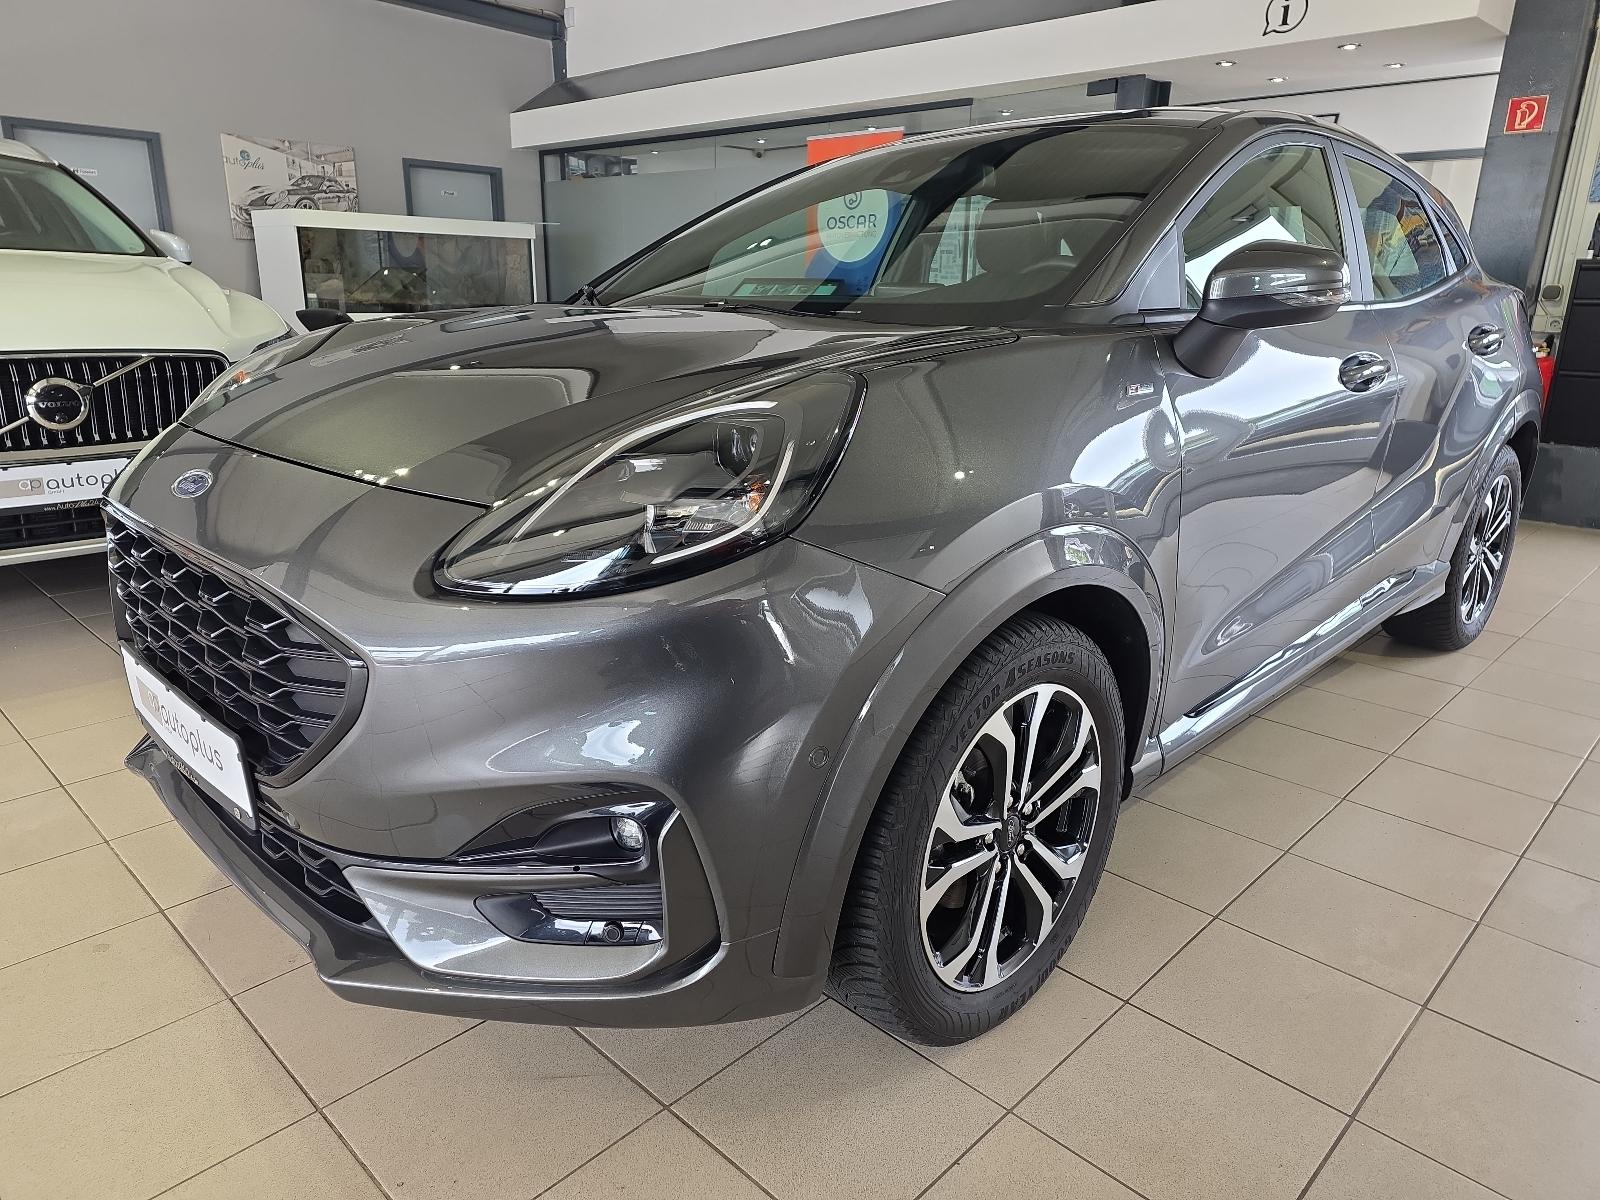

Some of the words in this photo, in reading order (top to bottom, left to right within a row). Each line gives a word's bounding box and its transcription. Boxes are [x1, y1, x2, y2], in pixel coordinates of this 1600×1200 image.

[826, 213, 877, 230] OSCAR
[160, 704, 224, 772] autoplus
[949, 683, 1001, 754] VECTOR
